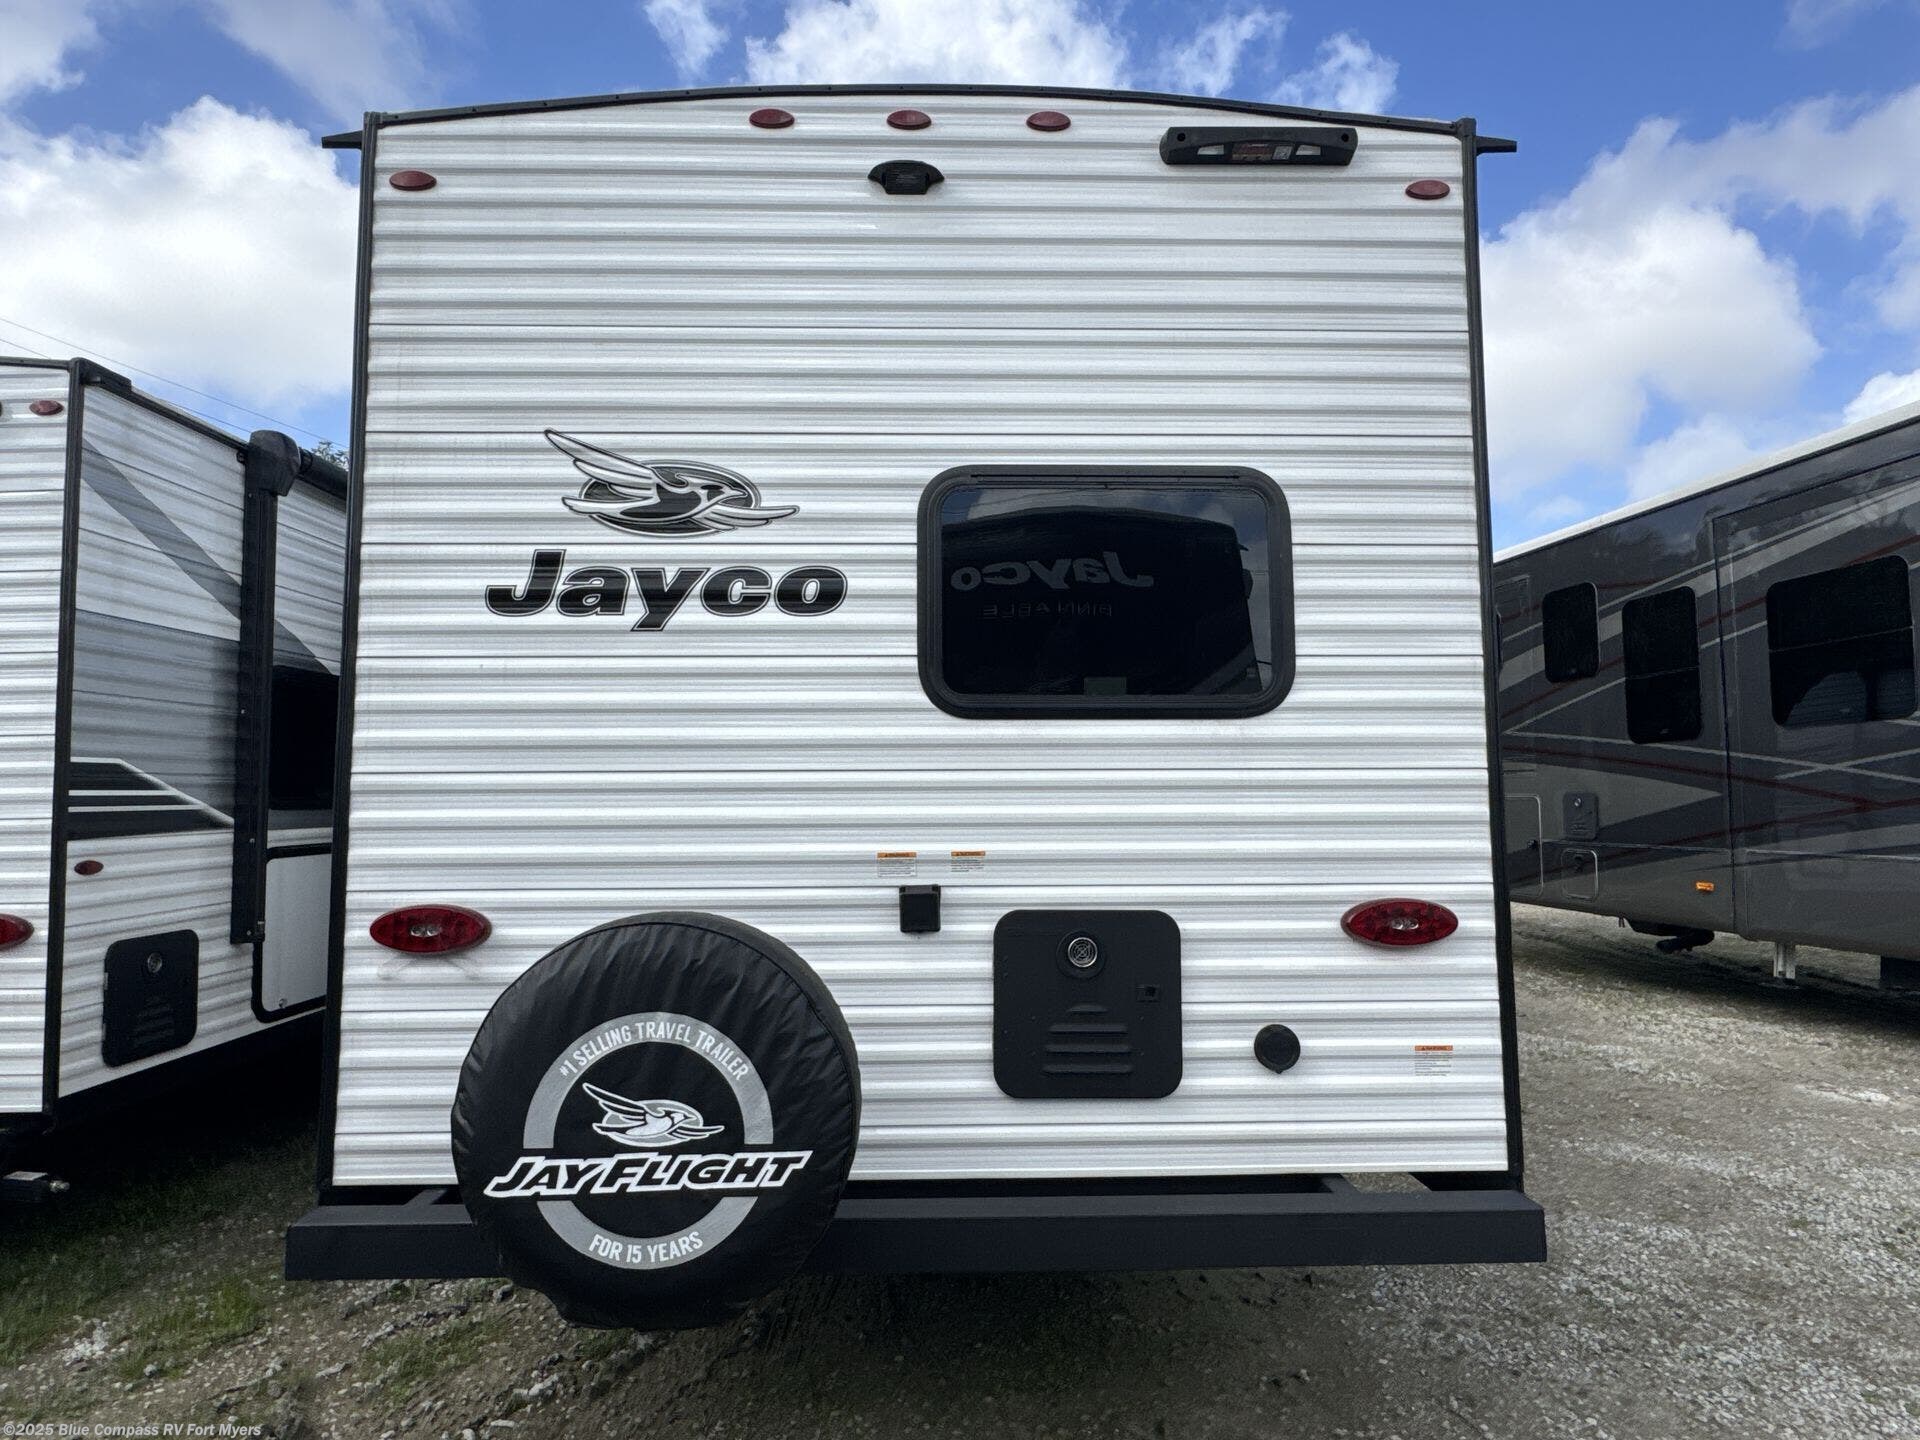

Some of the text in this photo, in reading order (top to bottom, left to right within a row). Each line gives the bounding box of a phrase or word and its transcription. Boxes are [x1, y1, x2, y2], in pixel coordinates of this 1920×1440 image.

[485, 549, 848, 632] Jayco
[559, 1021, 749, 1081] #1 SELLING TRAVEL TRAILER
[588, 1231, 703, 1263] FOR 15 YEARS
